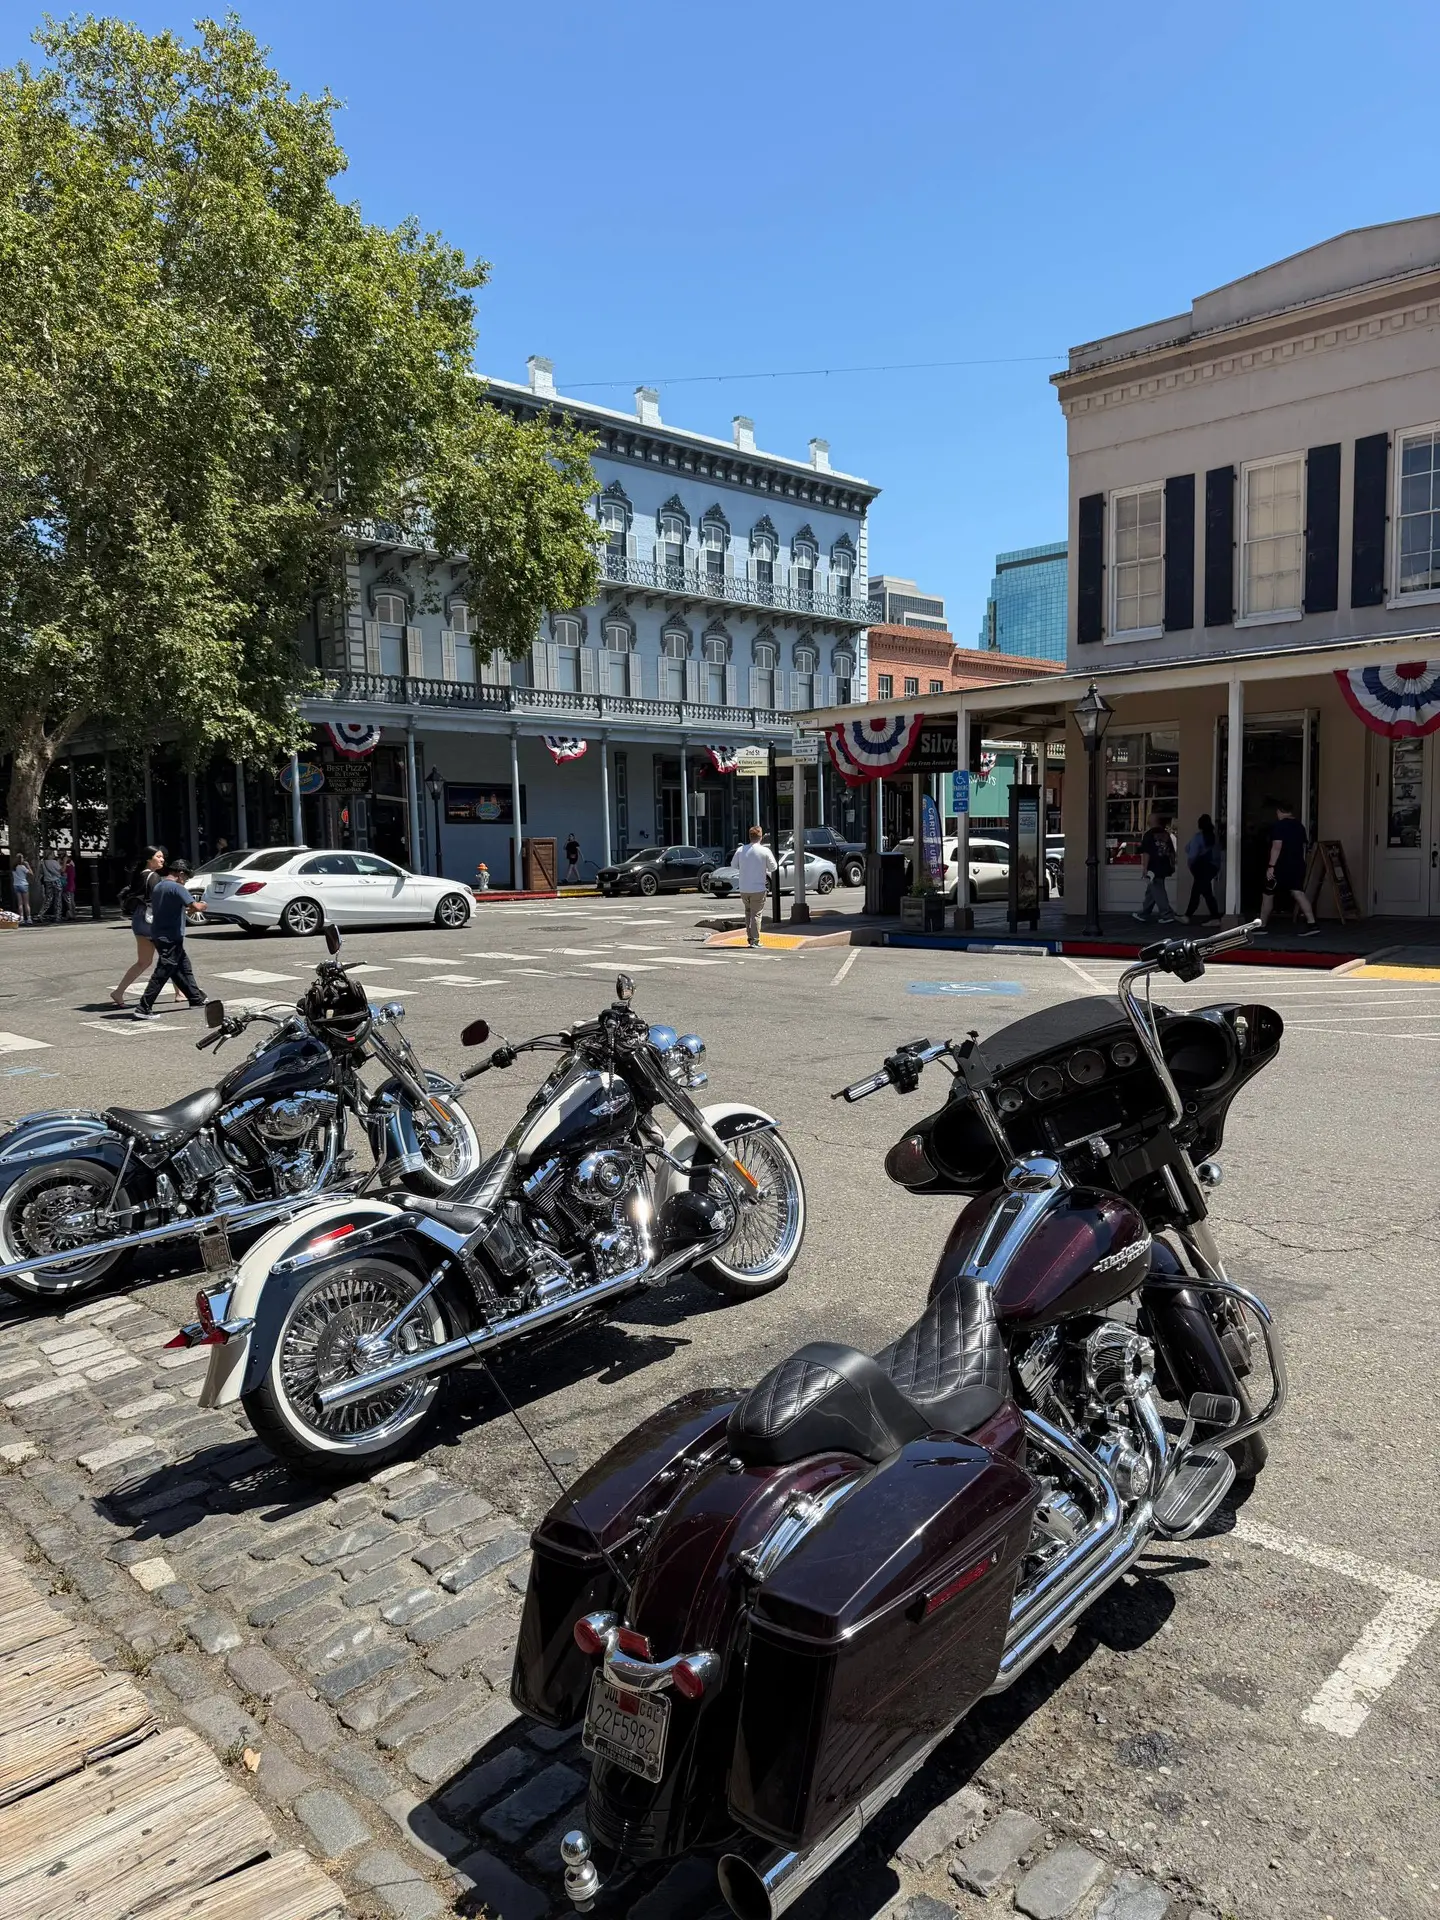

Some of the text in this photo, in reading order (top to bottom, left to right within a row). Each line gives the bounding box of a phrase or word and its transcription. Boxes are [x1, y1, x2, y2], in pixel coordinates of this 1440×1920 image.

[921, 733, 958, 753] Silve
[326, 764, 368, 772] BEST PIZZA
[604, 1686, 619, 1705] JUL
[639, 1703, 659, 1724] CAL
[594, 1704, 659, 1755] 22F5982
